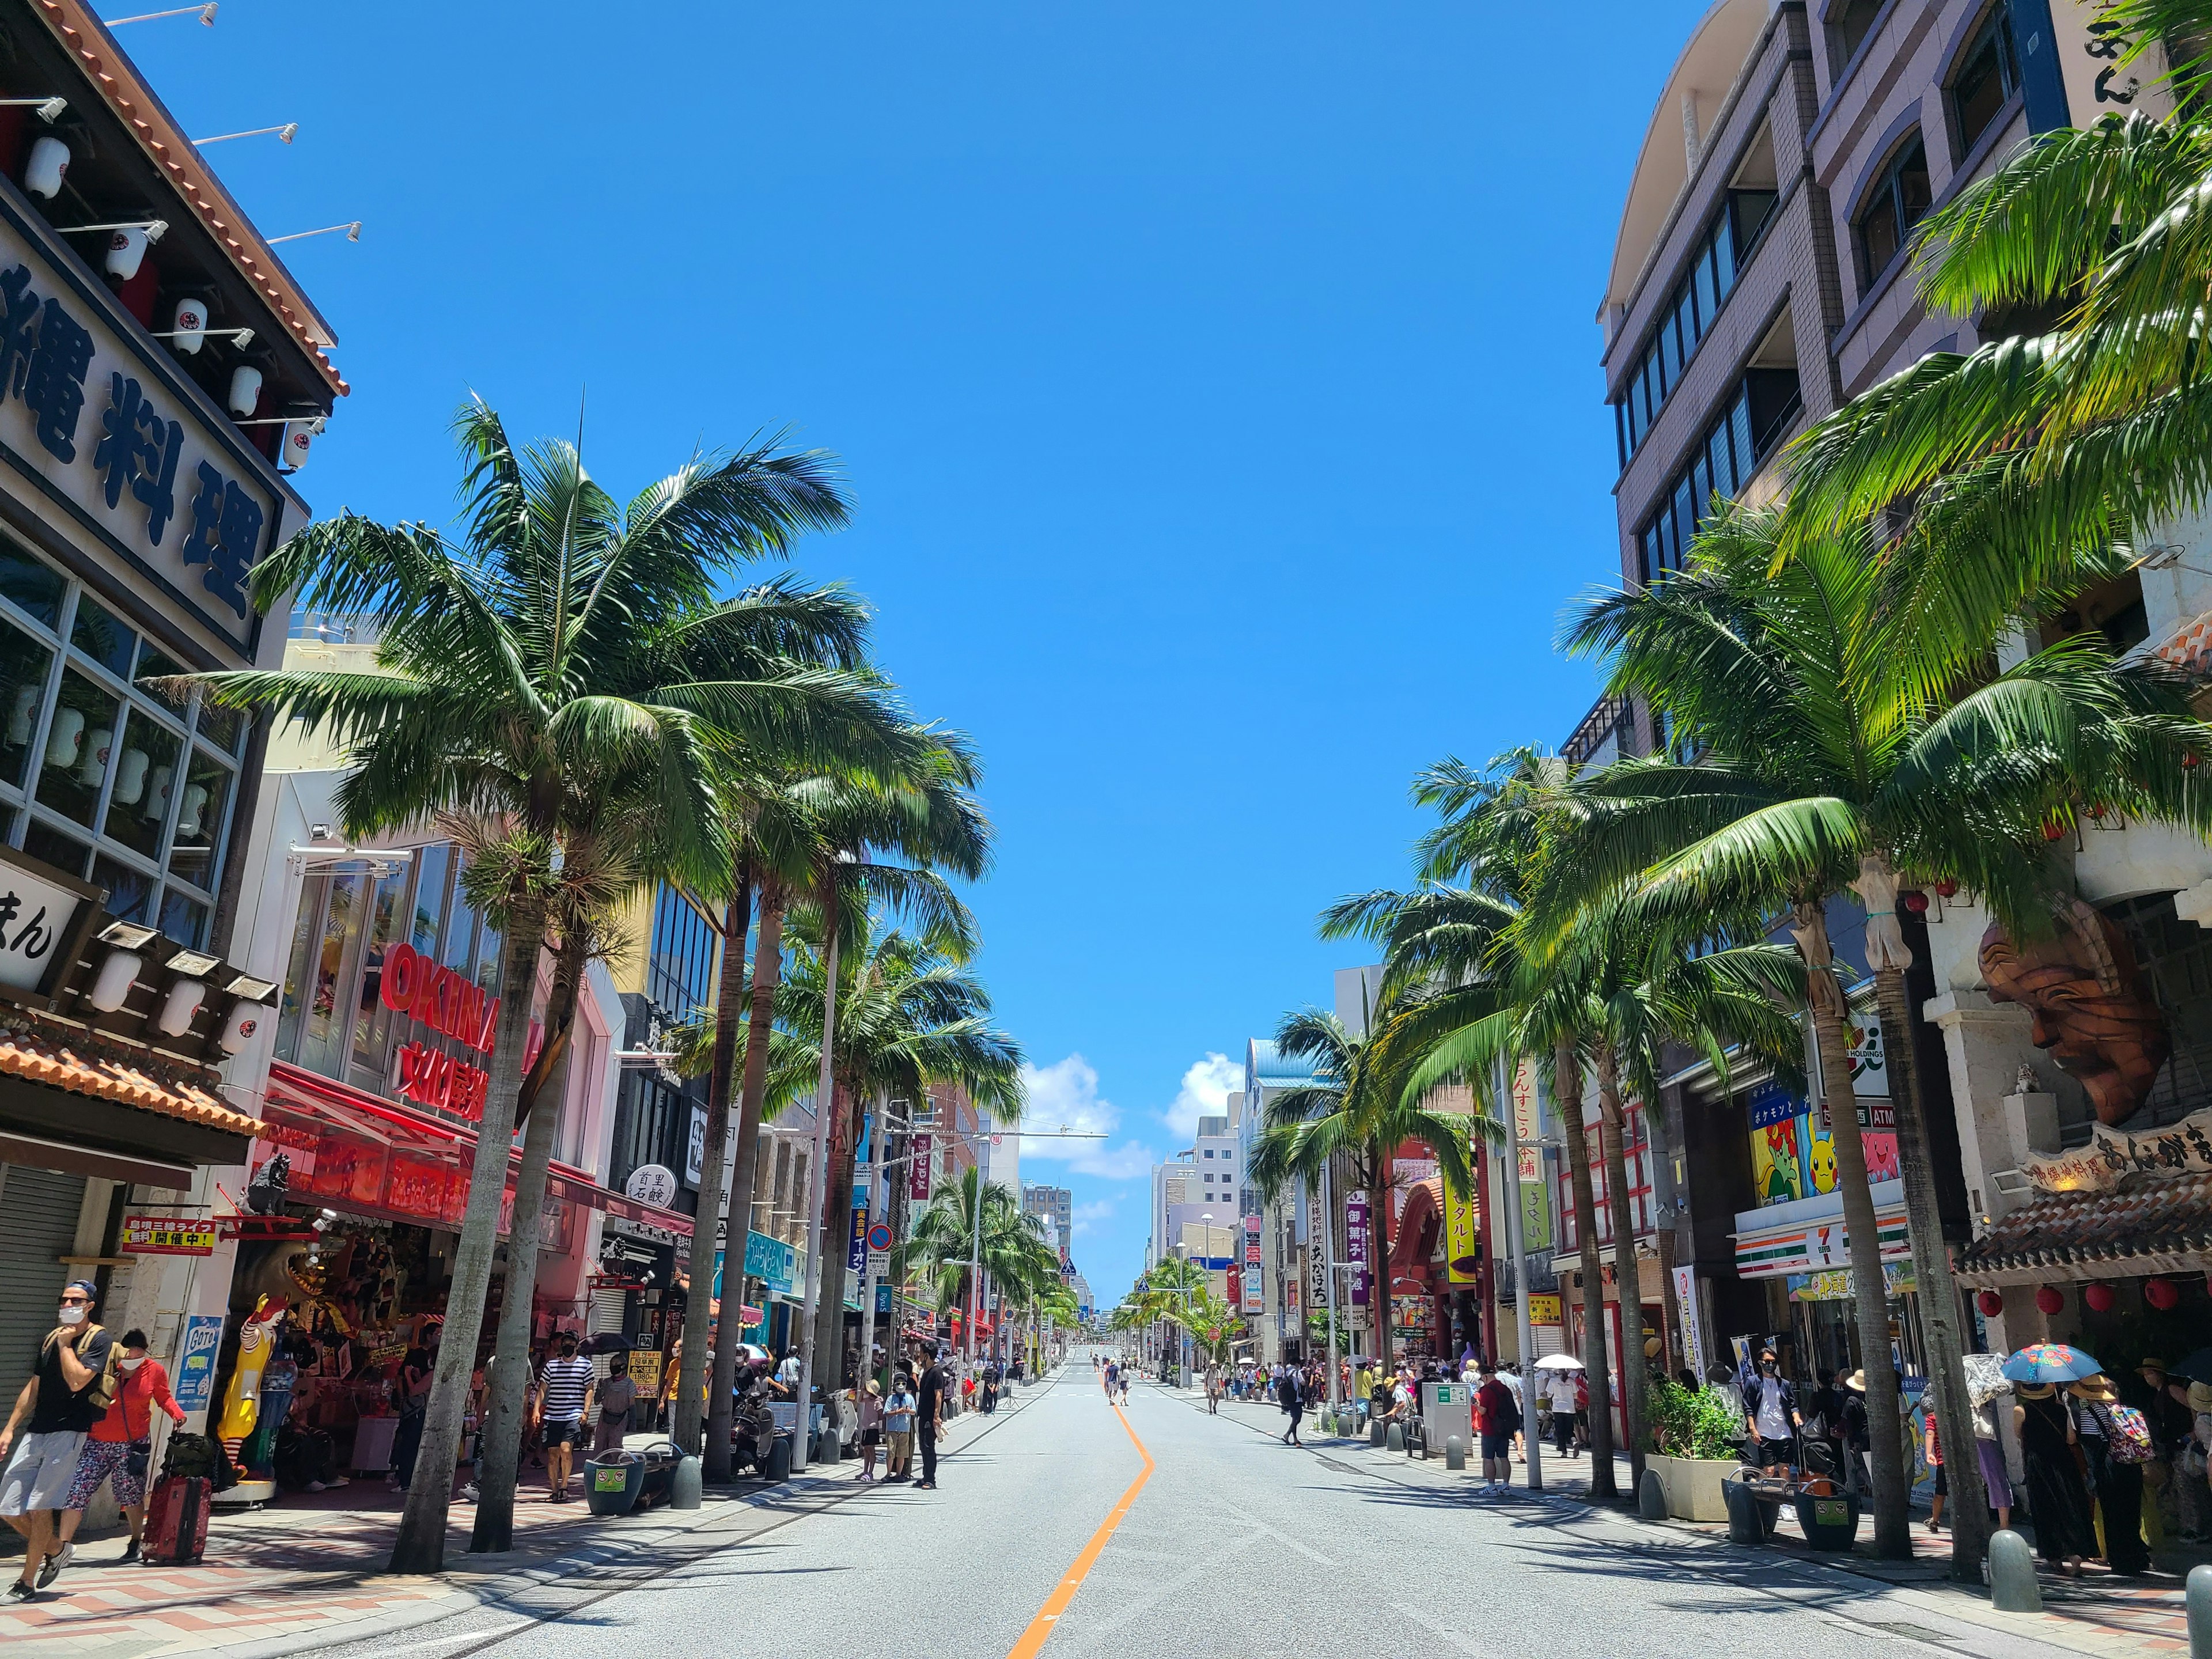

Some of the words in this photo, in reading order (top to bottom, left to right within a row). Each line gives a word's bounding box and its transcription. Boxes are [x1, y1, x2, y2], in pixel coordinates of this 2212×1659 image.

[381, 943, 500, 1057] OKINA
[1851, 1050, 1883, 1058] HOLDINGS
[394, 1041, 490, 1122] 文化屋雑
[1873, 1109, 1895, 1125] ATM
[639, 1171, 665, 1187] 首里
